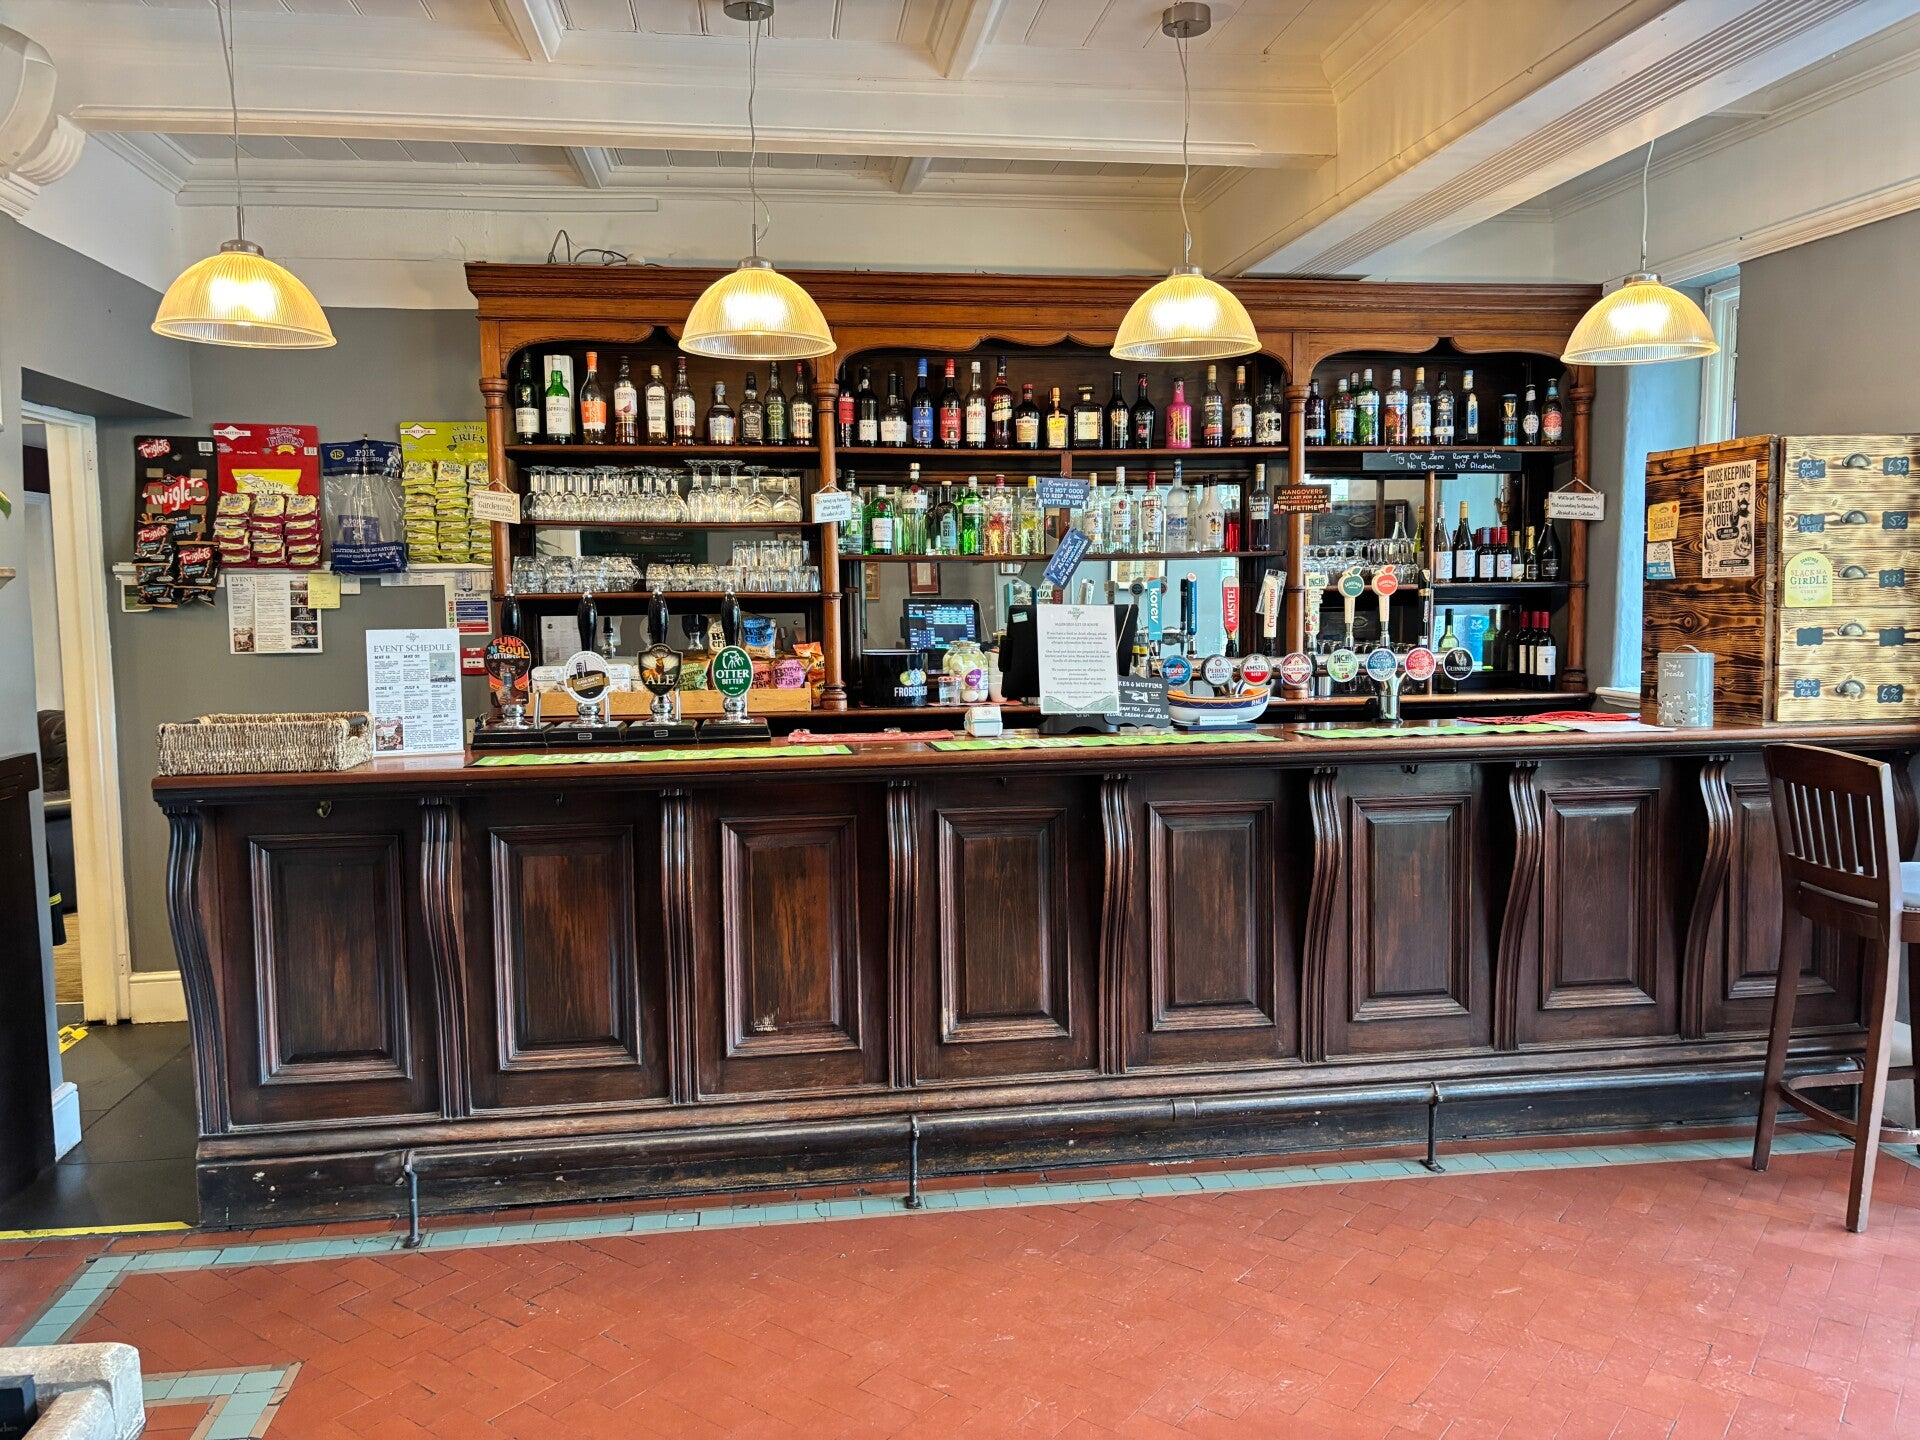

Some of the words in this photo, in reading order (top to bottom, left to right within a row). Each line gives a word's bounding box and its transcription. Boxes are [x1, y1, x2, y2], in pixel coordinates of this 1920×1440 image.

[452, 433, 486, 443] FRIES
[138, 439, 171, 458] Twiglets
[355, 449, 376, 457] PORK
[1390, 452, 1405, 465] Try
[1409, 453, 1423, 461] Our
[1428, 453, 1446, 461] Zero
[1452, 453, 1471, 464] Range
[1407, 462, 1417, 470] No
[1455, 462, 1466, 470] No
[1706, 469, 1723, 484] HOUSE
[1723, 464, 1752, 481] KEEPING
[1800, 469, 1819, 478] Rosie
[1706, 490, 1723, 503] WASH
[1723, 487, 1736, 500] UPS
[478, 500, 512, 514] Gardening
[1043, 498, 1071, 506] BOTTLED
[1286, 504, 1318, 512] LIFETIME
[1707, 502, 1717, 515] WE
[1717, 500, 1733, 514] NEED
[1712, 513, 1729, 528] YOU!
[138, 524, 169, 542] Twiglets
[178, 547, 212, 564] Twiglets
[1057, 567, 1067, 580] LOW
[1059, 574, 1068, 585] AND
[1065, 562, 1075, 576] POOR
[1789, 575, 1829, 585] GIRDLE
[1149, 587, 1160, 625] korev
[1227, 587, 1236, 624] AMSTEL
[1267, 588, 1276, 629] Cruzcampo
[373, 645, 404, 653] EVENT
[405, 643, 452, 652] SCHEDULE
[492, 636, 522, 647] FUNK
[487, 645, 498, 654] 'N
[498, 645, 530, 659] SOUL
[715, 669, 750, 679] OTTER
[1166, 667, 1187, 675] korev
[1662, 668, 1685, 679] Treats
[645, 674, 675, 686] ALE
[1881, 688, 1899, 701] 6%
